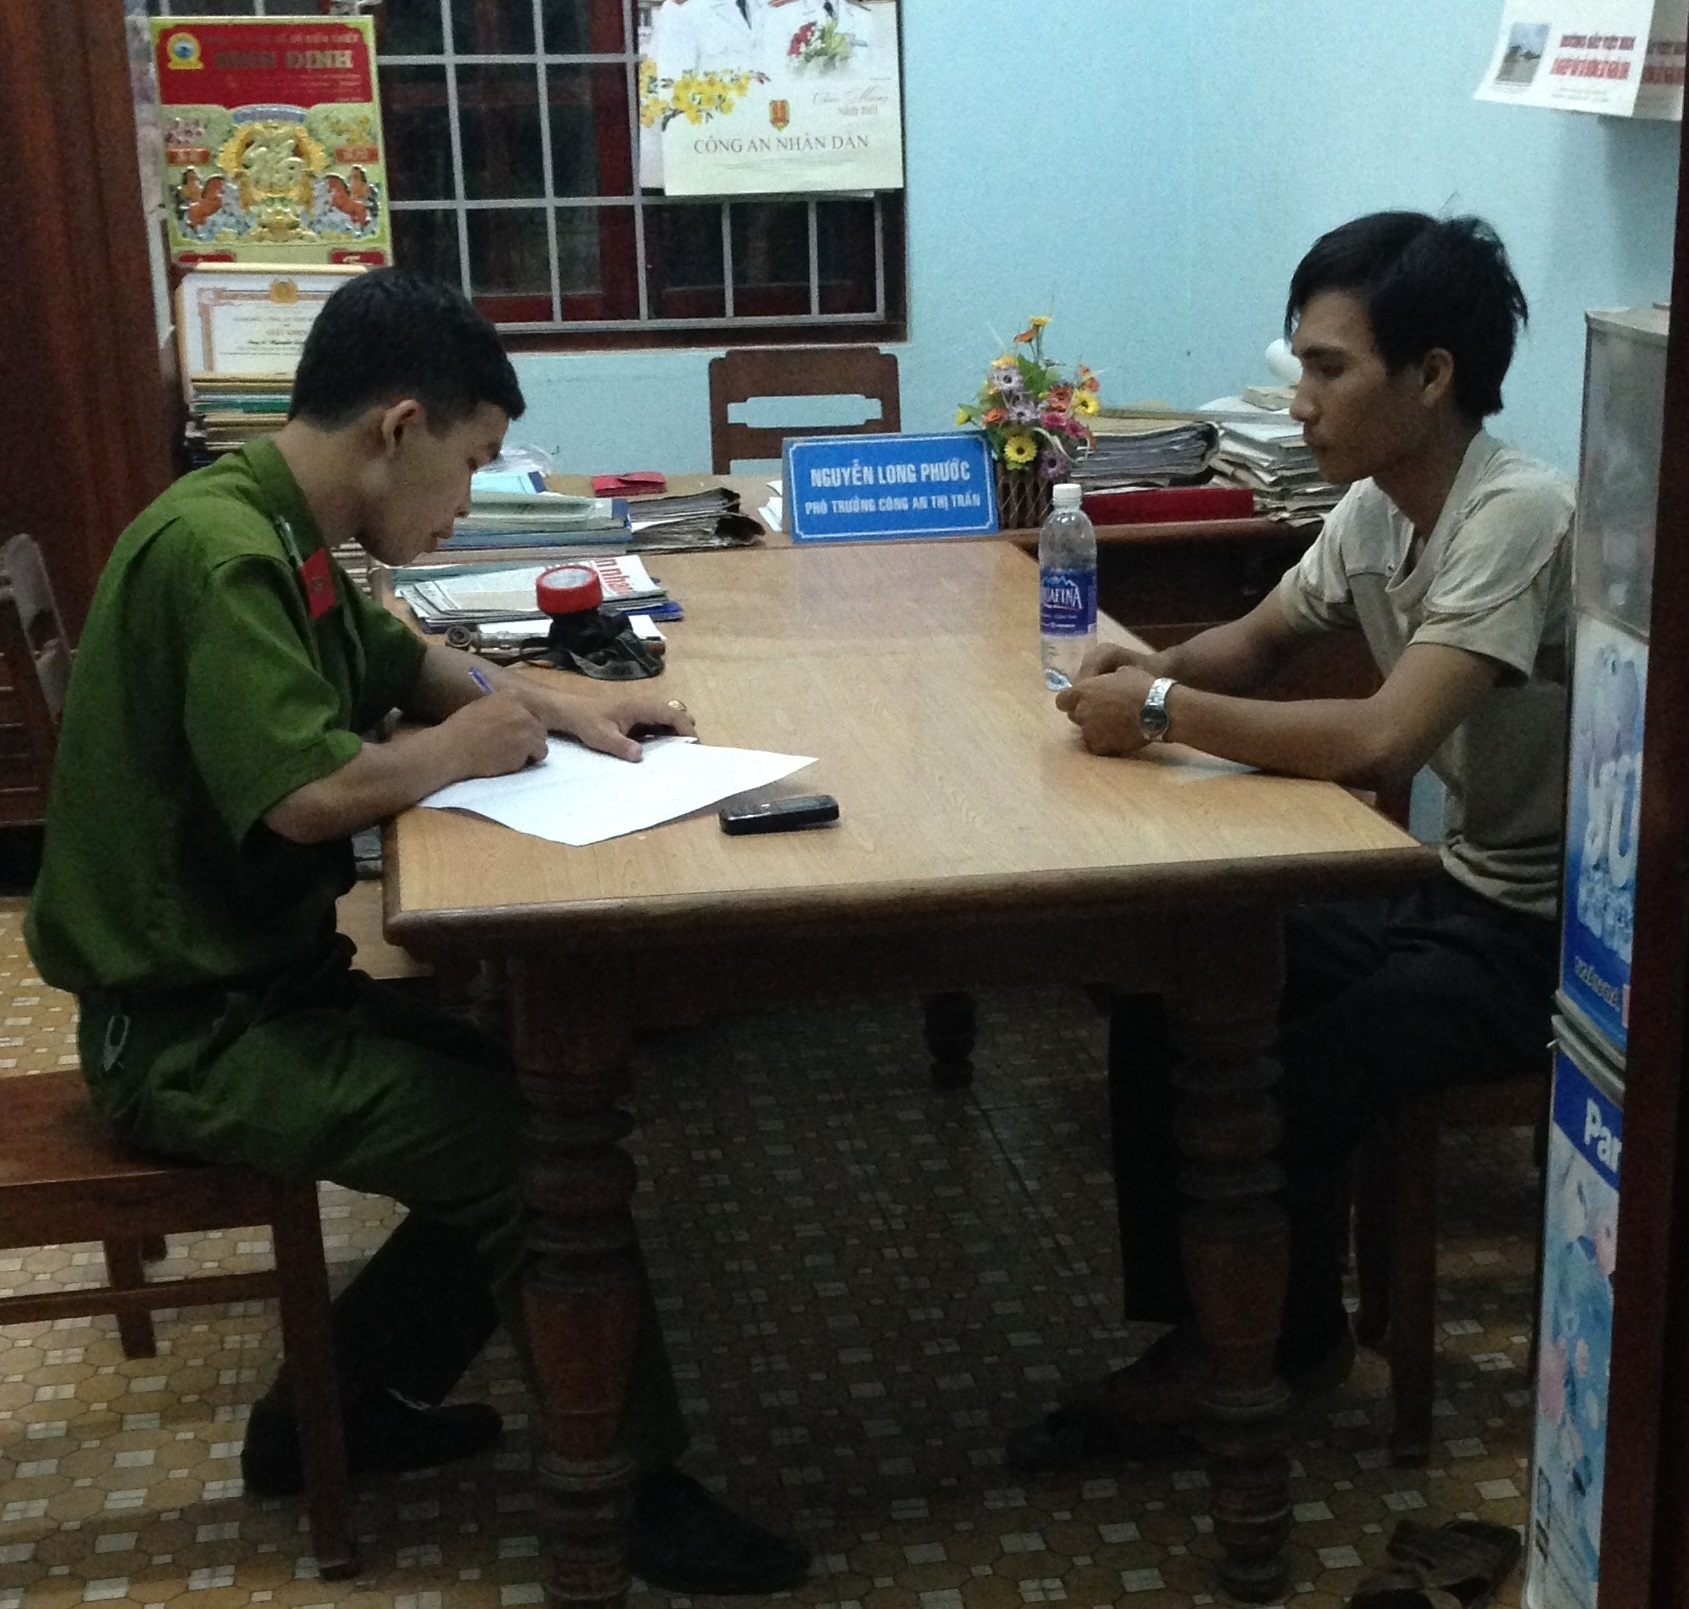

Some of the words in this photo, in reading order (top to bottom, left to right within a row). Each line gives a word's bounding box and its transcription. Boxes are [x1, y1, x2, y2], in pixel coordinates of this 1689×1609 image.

[694, 135, 743, 154] CÔNG
[748, 138, 771, 152] AN
[776, 133, 826, 151] NHÂN
[832, 133, 869, 150] DÂN
[810, 459, 874, 487] NGUYỄN
[877, 463, 917, 485] LONG
[920, 457, 971, 482] PHƯỚC
[805, 498, 828, 515] PHÓ
[878, 495, 909, 512] CÔNG
[912, 496, 928, 510] AN
[930, 495, 949, 511] THỊ
[951, 490, 981, 508] TRẤN
[1041, 586, 1083, 609] UAFINA
